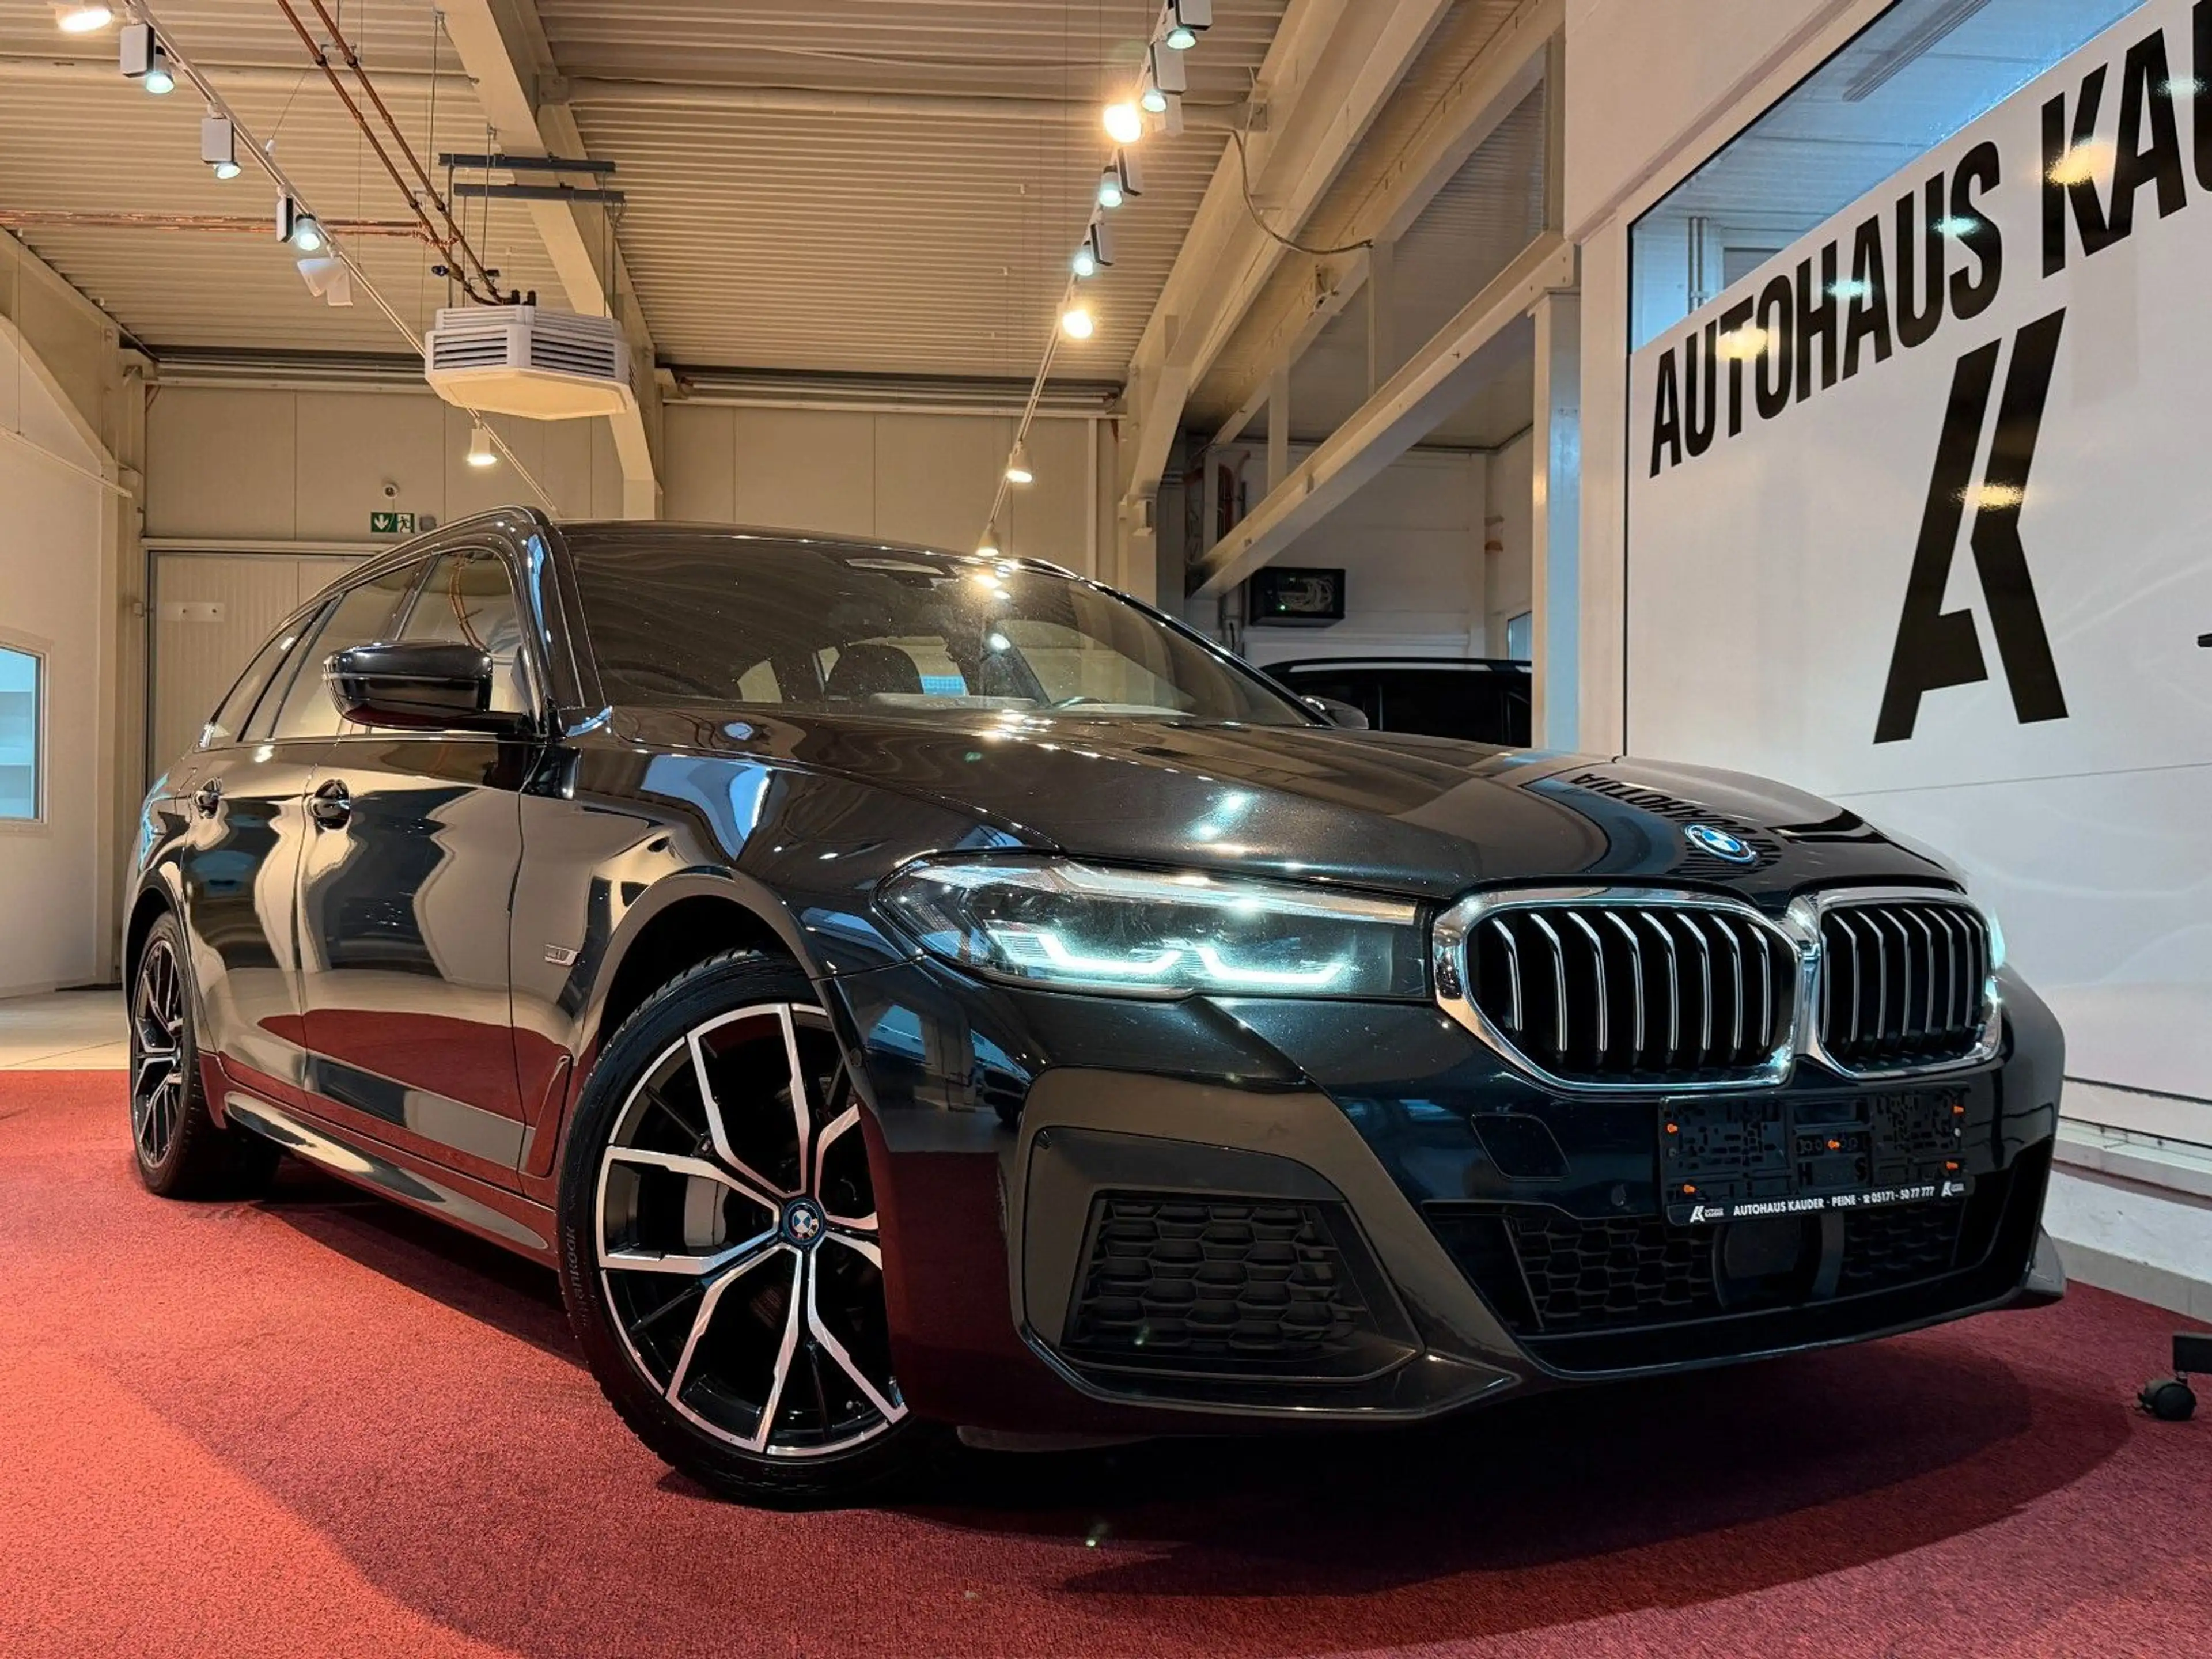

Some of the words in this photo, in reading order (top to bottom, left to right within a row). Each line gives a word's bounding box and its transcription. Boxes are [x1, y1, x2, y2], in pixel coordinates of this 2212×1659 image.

[1649, 141, 2002, 479] AUTOHAUS
[1733, 1202, 1786, 1216] AUTOHAUS
[1787, 1198, 1824, 1211] KAUDER
[1831, 1194, 1856, 1207] PEINE
